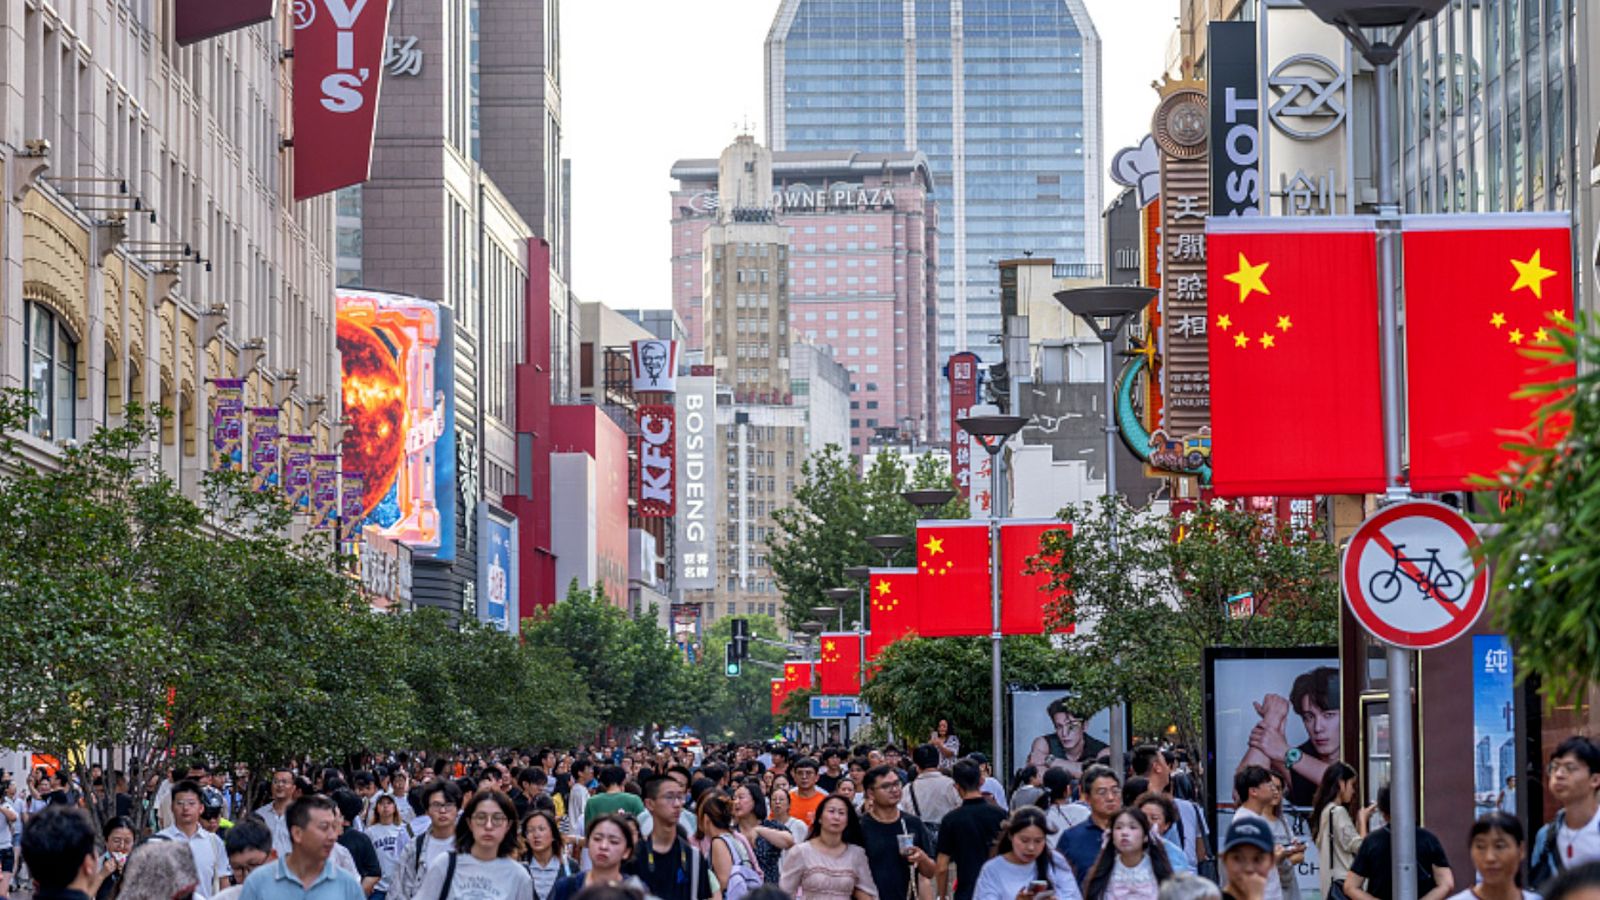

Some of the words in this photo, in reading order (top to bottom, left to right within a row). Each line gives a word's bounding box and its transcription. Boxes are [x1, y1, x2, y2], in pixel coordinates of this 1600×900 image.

[1225, 87, 1259, 216] SOT
[834, 189, 895, 206] PLAZA
[641, 414, 672, 504] KFC
[686, 394, 705, 542] BOSIDENG
[1485, 649, 1508, 673] 纯
